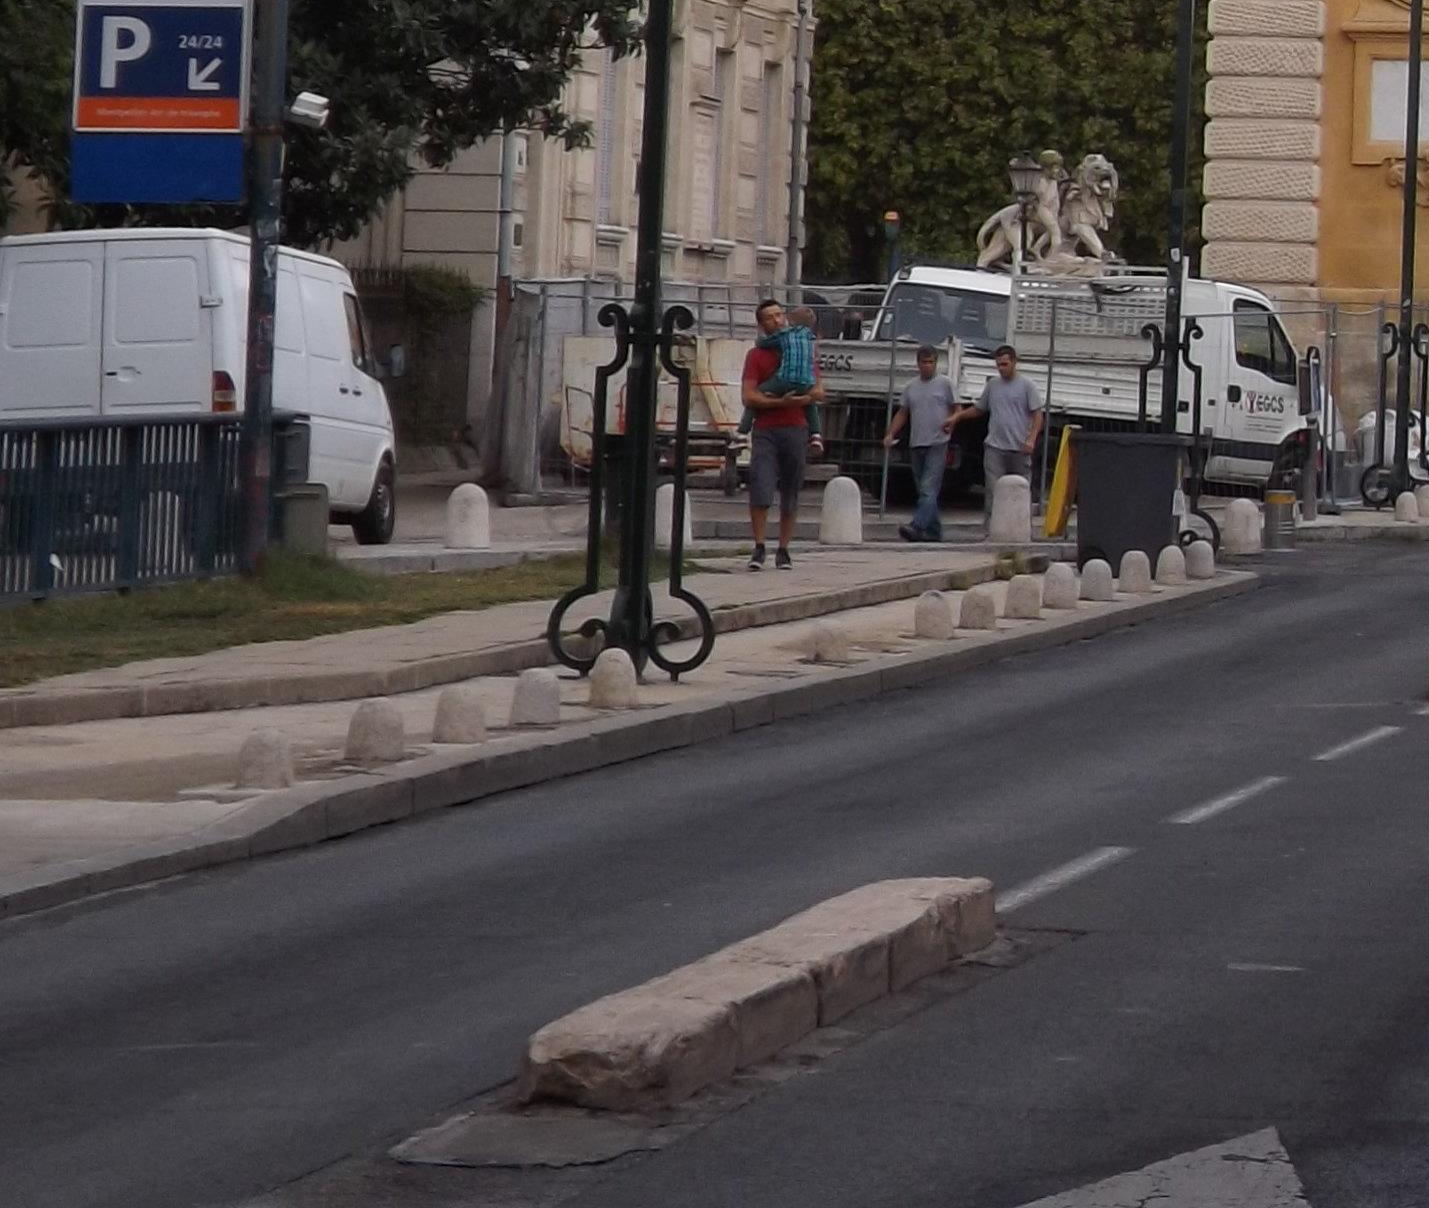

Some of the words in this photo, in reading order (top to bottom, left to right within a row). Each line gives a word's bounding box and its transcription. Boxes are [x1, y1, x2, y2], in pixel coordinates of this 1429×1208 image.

[99, 15, 152, 89] P
[178, 34, 223, 50] 24/24
[1256, 394, 1285, 414] EGCS
